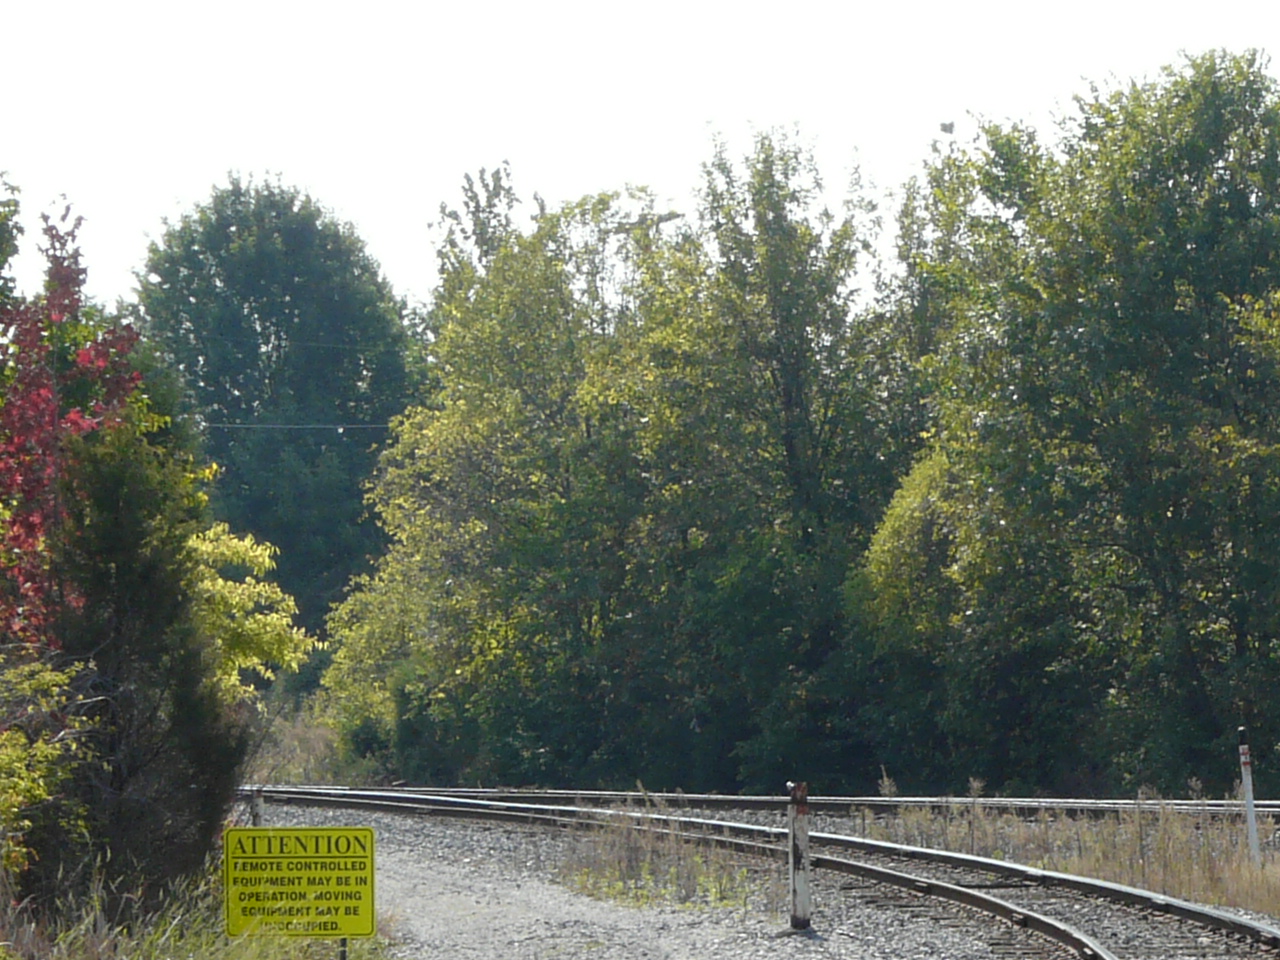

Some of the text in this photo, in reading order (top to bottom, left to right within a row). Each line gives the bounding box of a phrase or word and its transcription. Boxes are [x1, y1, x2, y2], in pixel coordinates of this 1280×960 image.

[232, 834, 367, 855] ATTENTION
[233, 861, 367, 872] REMOTE CONTROLLED
[233, 876, 368, 887] EQUIPMENT MAY BE IN
[314, 891, 362, 901] MOVING
[241, 906, 360, 917] EQUIPMENT MAY BE
[260, 921, 342, 932] OCCUPIED.
